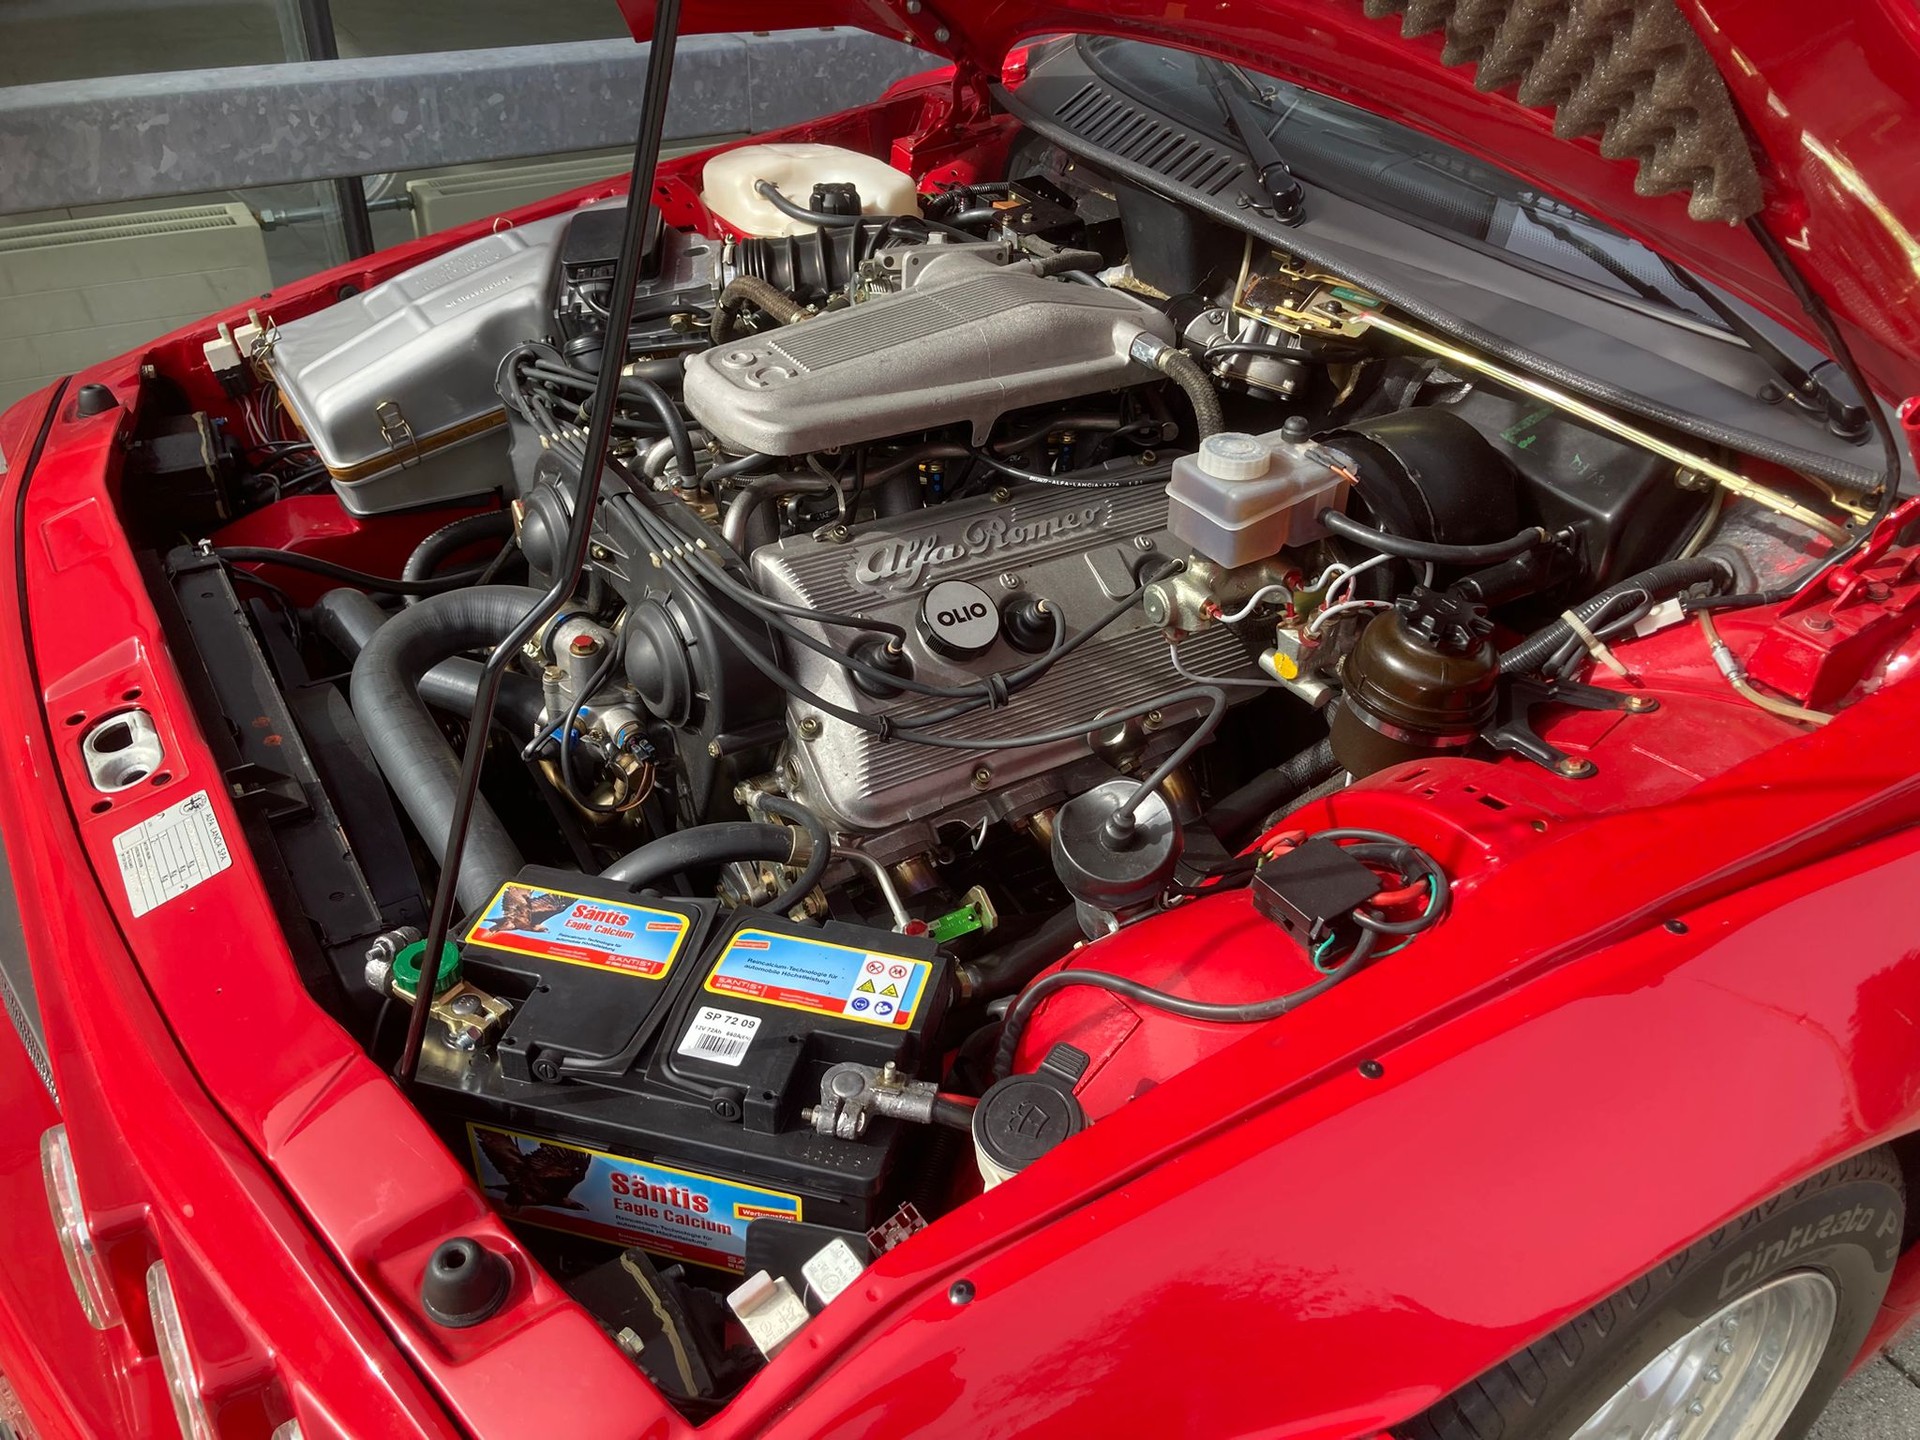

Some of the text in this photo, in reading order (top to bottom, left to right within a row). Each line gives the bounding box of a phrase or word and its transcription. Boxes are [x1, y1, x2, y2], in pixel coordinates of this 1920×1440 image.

[856, 507, 1100, 589] Alfa Romeo
[937, 602, 988, 627] OLIO
[571, 903, 630, 926] Säntis
[564, 919, 593, 931] Eagle
[594, 924, 636, 939] Calcium
[704, 1011, 756, 1029] SP 72 09
[610, 1171, 709, 1214] Säntis
[613, 1199, 732, 1236] Eagle Calcium
